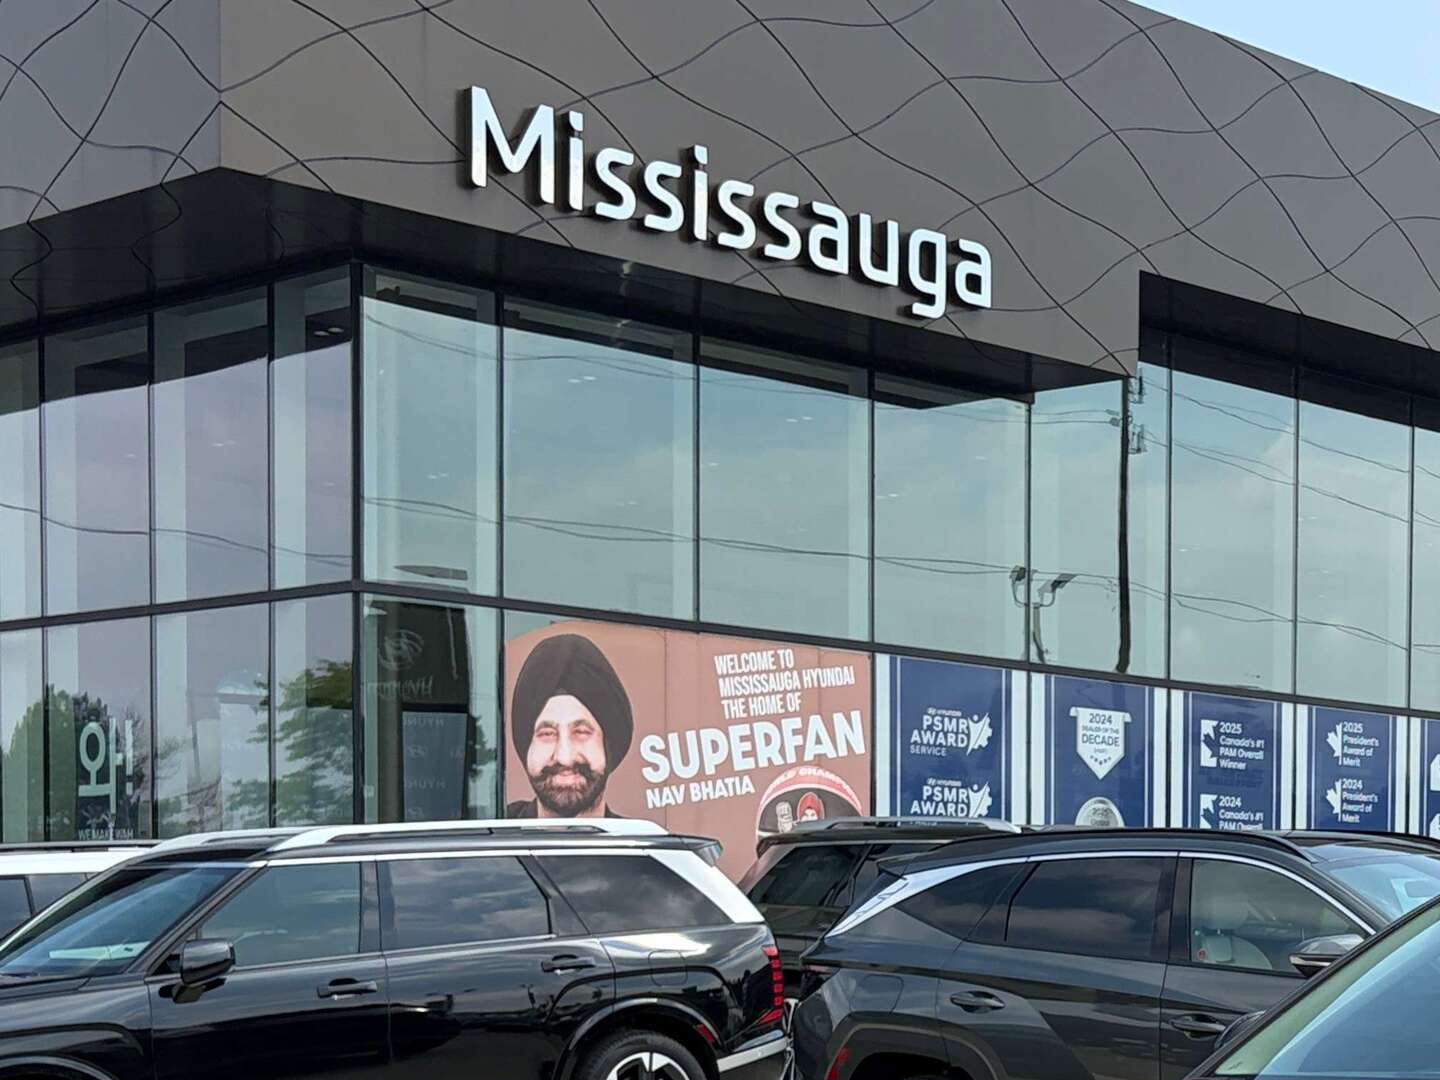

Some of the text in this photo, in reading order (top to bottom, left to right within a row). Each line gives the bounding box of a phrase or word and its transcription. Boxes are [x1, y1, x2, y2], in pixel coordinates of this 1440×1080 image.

[470, 85, 992, 319] Mississauga
[714, 649, 795, 675] WELCOME TO
[718, 666, 855, 697] MISSISSAUGA HYUNDAI
[721, 692, 801, 719] THE HOME OF
[922, 715, 968, 734] PSMR
[1089, 713, 1113, 725] 2024
[1220, 722, 1243, 734] 2025
[1343, 722, 1363, 733] 2025
[910, 729, 968, 748] AWARD
[1082, 734, 1120, 747] DECADE
[1220, 736, 1255, 748] Canada's
[639, 710, 865, 784] SUPERFAN
[910, 745, 947, 757] SERVICE
[1343, 746, 1374, 757] Award of
[1220, 748, 1264, 760] PAM Overall
[1220, 759, 1246, 770] Winner
[1343, 757, 1360, 767] Merit
[1342, 779, 1363, 790] 2024
[646, 785, 688, 809] NAV
[690, 774, 755, 802] BHATIA
[922, 785, 968, 804] PSMR
[1219, 796, 1242, 808] 2024
[910, 800, 968, 818] AWARD
[1219, 821, 1236, 831] PAM
